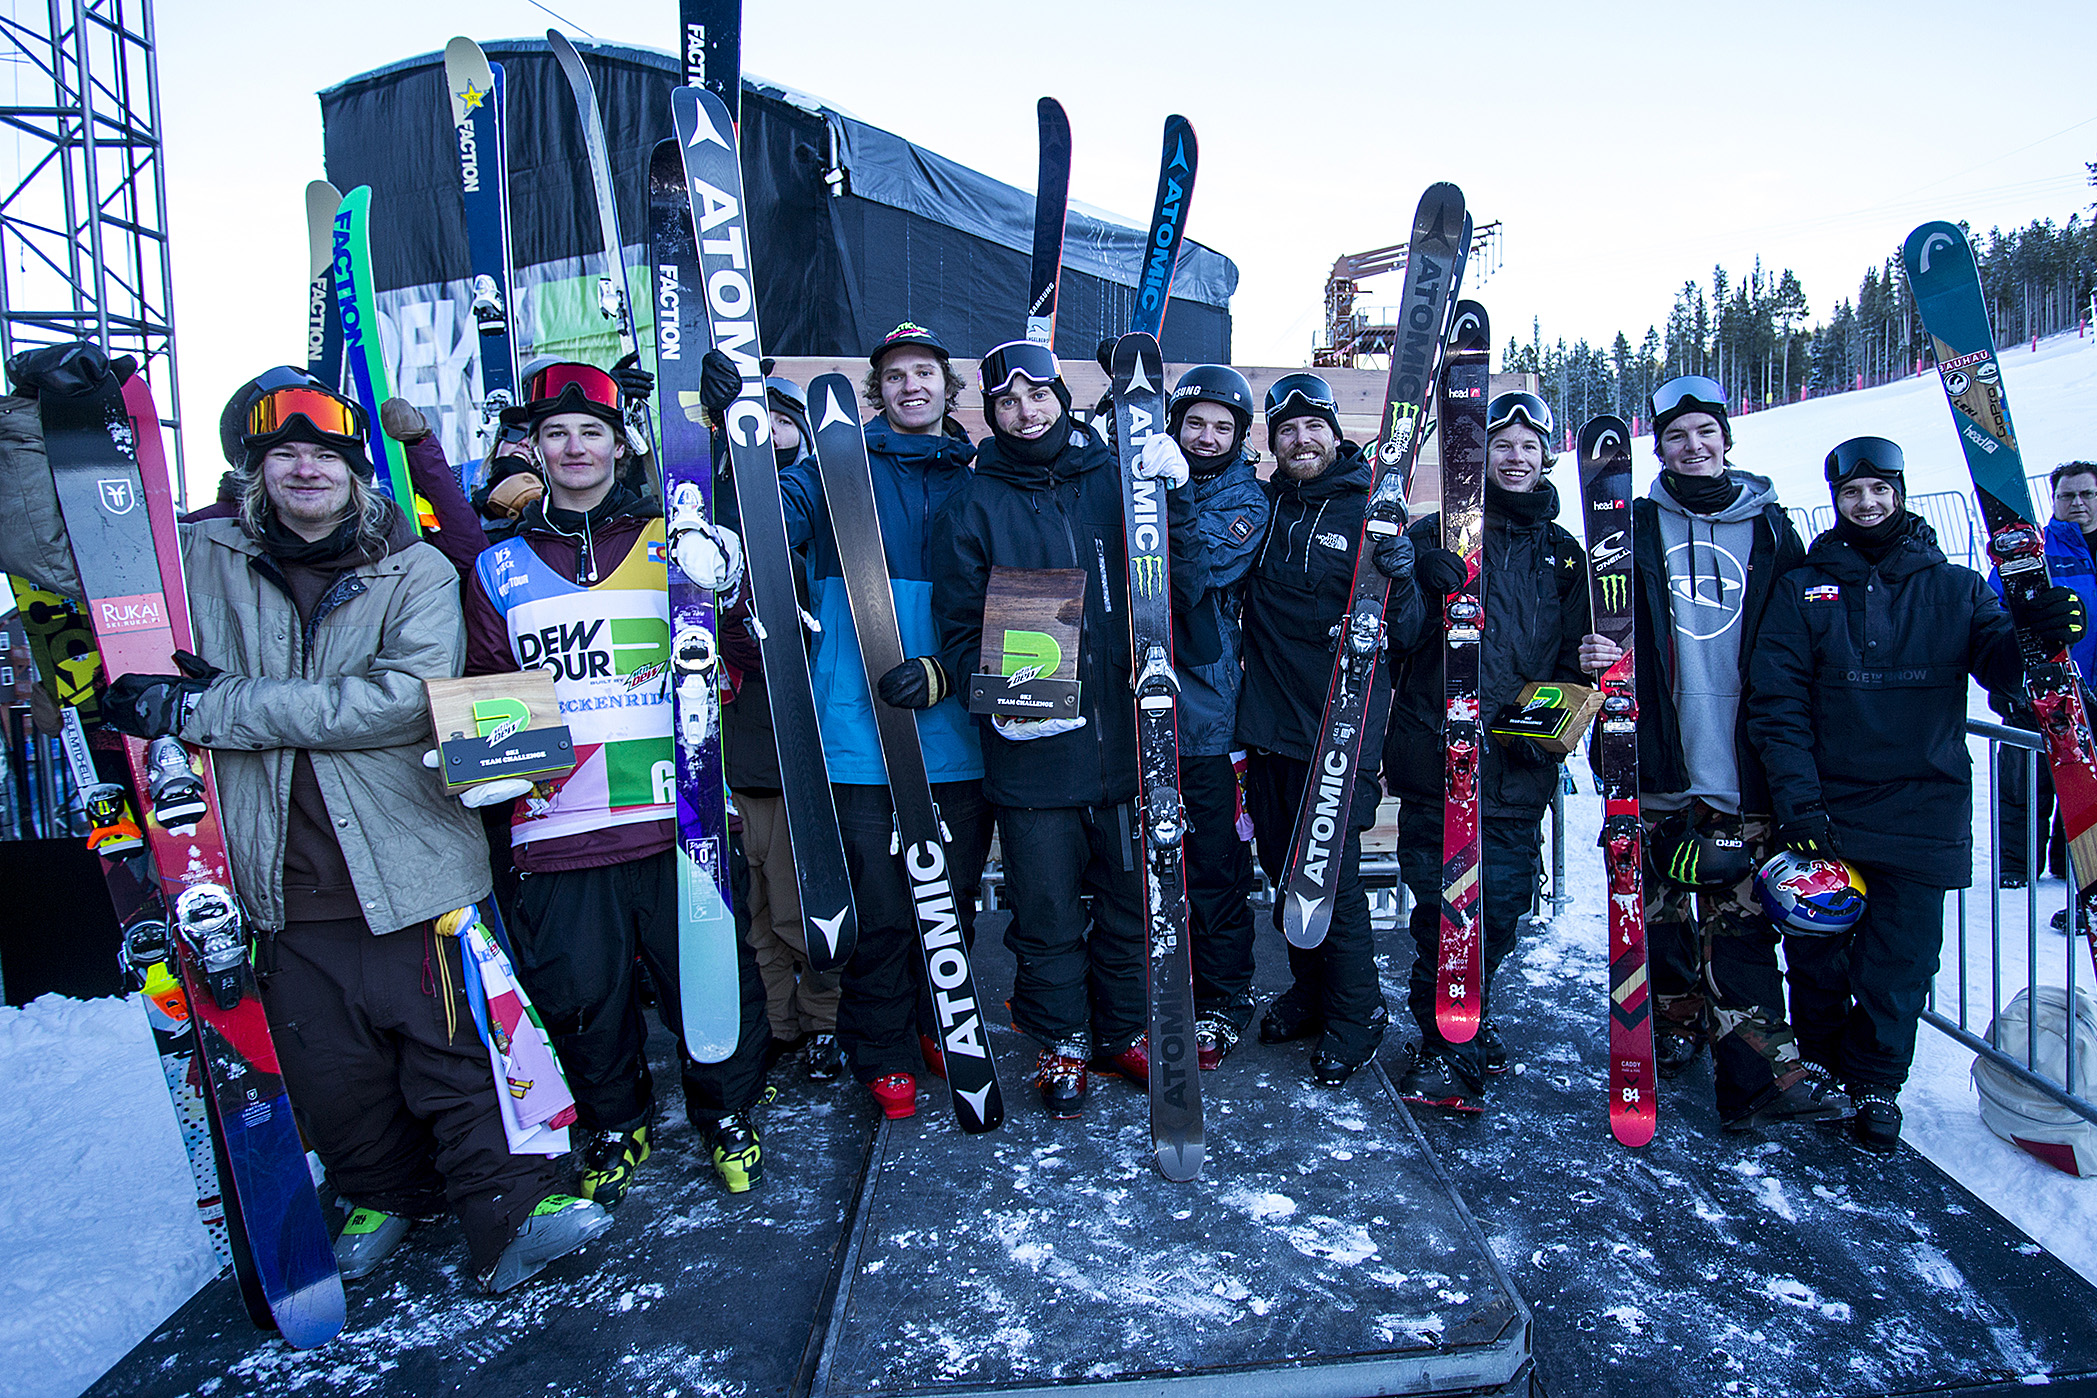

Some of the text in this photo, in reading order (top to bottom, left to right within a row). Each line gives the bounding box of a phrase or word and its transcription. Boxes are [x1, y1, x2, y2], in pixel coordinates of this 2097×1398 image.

[687, 24, 705, 90] FACTI
[458, 119, 480, 192] FACTION
[1141, 177, 1184, 311] ATOMIC
[332, 209, 363, 349] FACTION
[659, 264, 681, 360] FACTION
[694, 176, 770, 447] ATOMIC
[1029, 282, 1055, 316] SAMSUNG
[308, 277, 328, 361] FACTION
[1396, 254, 1442, 401] ATOMIC
[1938, 349, 1991, 374] BAUHAU
[1449, 387, 1469, 399] head
[1953, 399, 1978, 417] LEKI
[1987, 387, 2006, 438] GoPro
[1963, 424, 1990, 447] head
[1593, 500, 1614, 511] head
[101, 602, 160, 623] RUKA!
[517, 618, 605, 665] DEW
[524, 649, 612, 684] OUR
[997, 698, 1054, 708] TEAM CHALLENGE
[480, 751, 547, 767] TEAM CHALLENGE
[505, 748, 519, 757] SKI
[1303, 750, 1349, 888] ATOMIC
[689, 848, 709, 864] 1.0
[906, 840, 986, 1058] ATOMIC
[1449, 983, 1466, 999] 84
[1621, 1060, 1641, 1068] CADDY
[1622, 1087, 1641, 1103] 84
